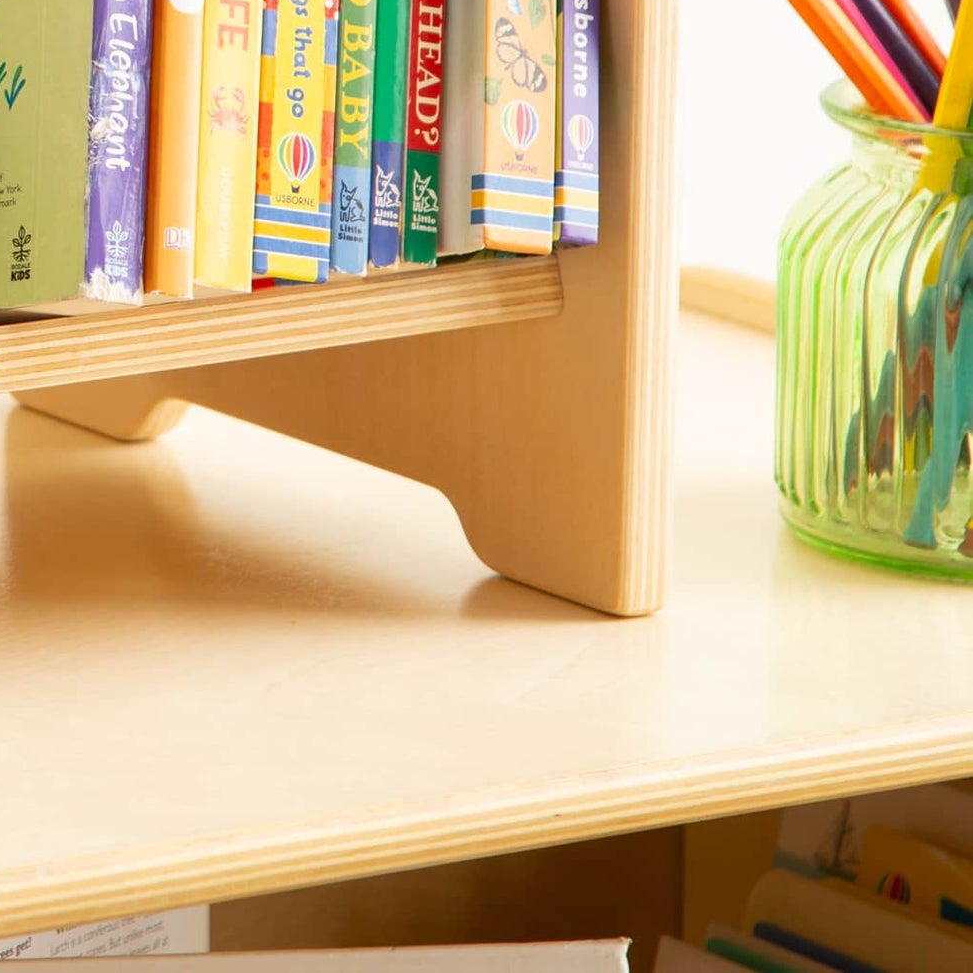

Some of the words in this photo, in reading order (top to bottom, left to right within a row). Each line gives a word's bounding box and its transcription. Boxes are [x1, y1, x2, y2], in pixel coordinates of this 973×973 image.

[293, 27, 313, 79] that
[414, 4, 444, 146] HEAD?
[105, 12, 138, 171] Elephant
[339, 22, 372, 160] BABY
[287, 88, 304, 119] go
[275, 194, 315, 207] USBORNE
[375, 209, 398, 219] Little
[412, 213, 436, 224] Little
[339, 223, 362, 234] Little
[373, 217, 399, 228] Simon
[411, 222, 437, 233] Simon
[338, 232, 363, 242] Simon
